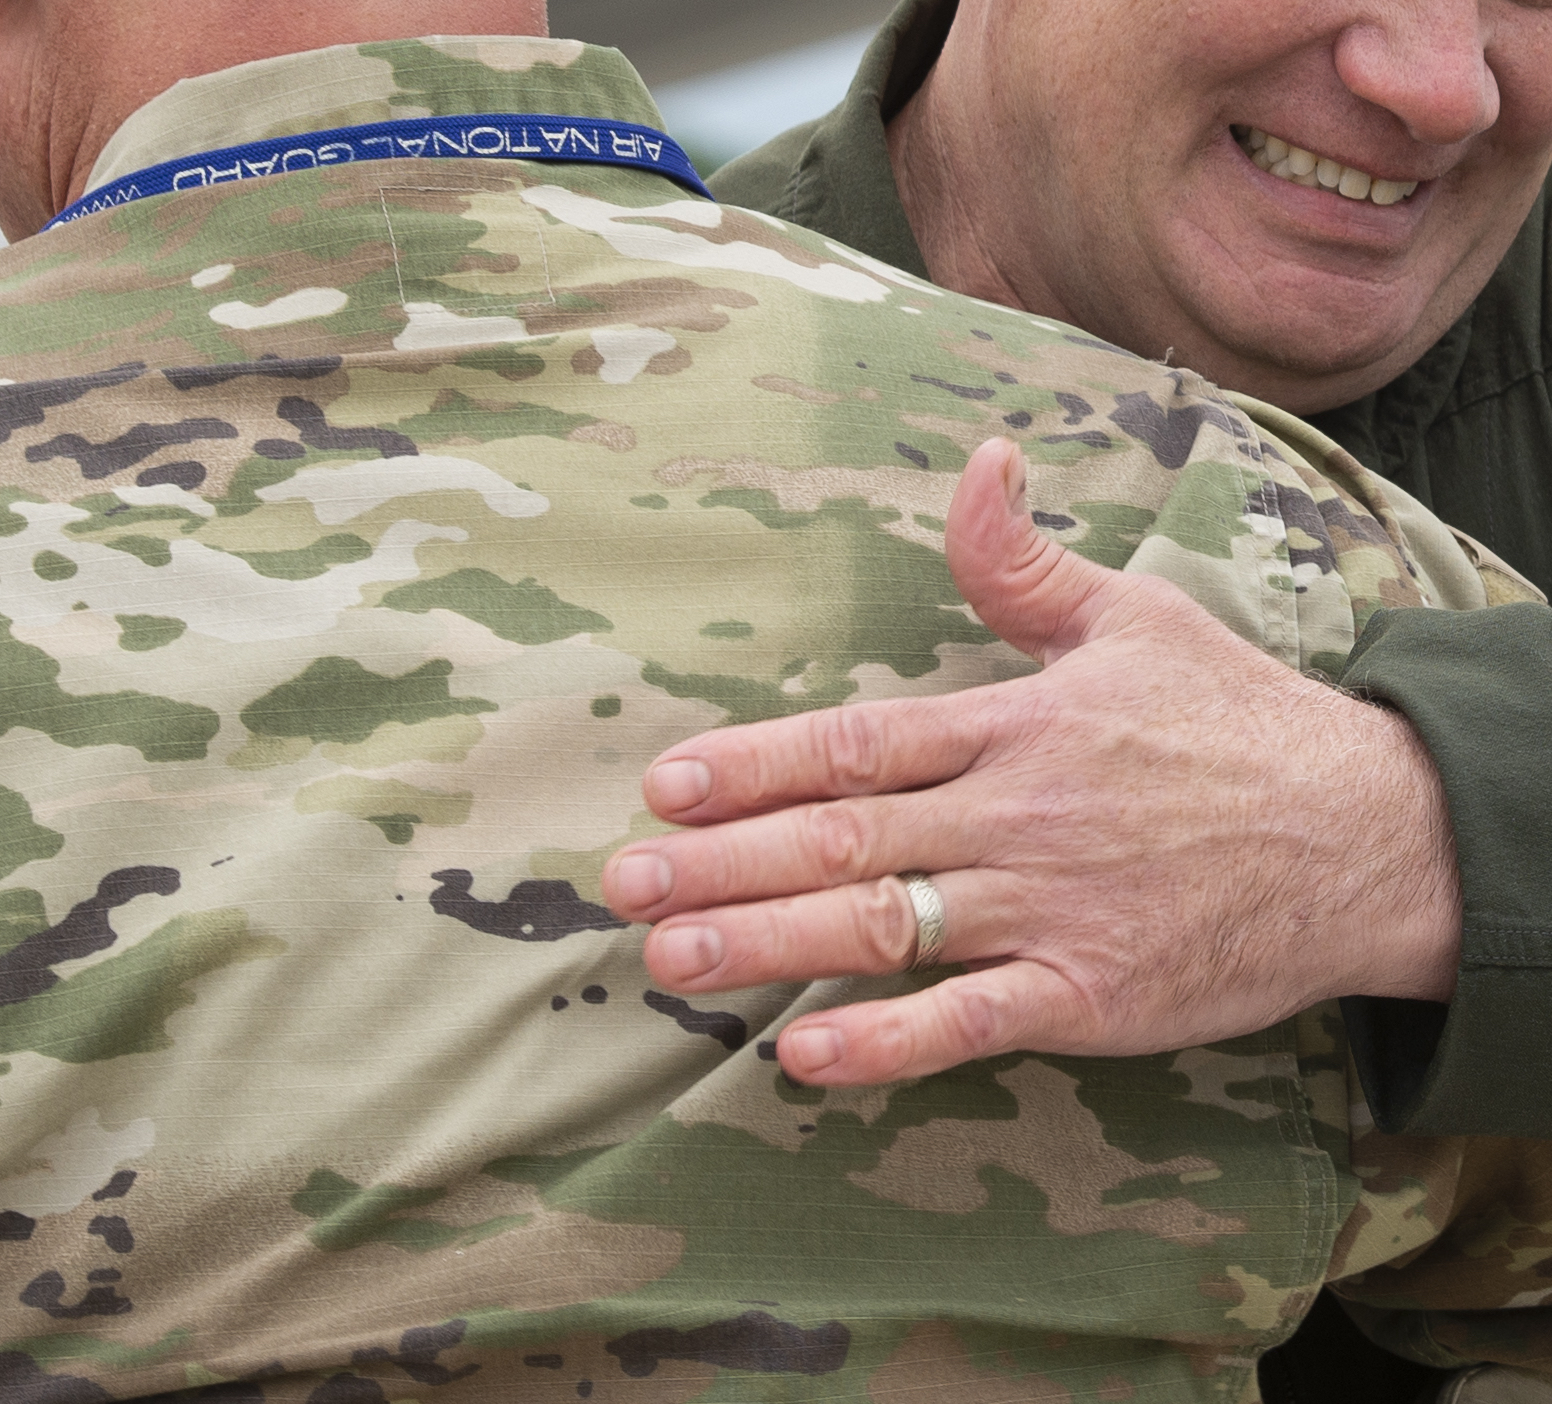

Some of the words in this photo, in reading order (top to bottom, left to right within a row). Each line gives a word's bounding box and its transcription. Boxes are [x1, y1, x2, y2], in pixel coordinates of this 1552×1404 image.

[361, 126, 600, 159] NATIONAL
[610, 129, 663, 162] AIR
[172, 141, 355, 191] GUARD
